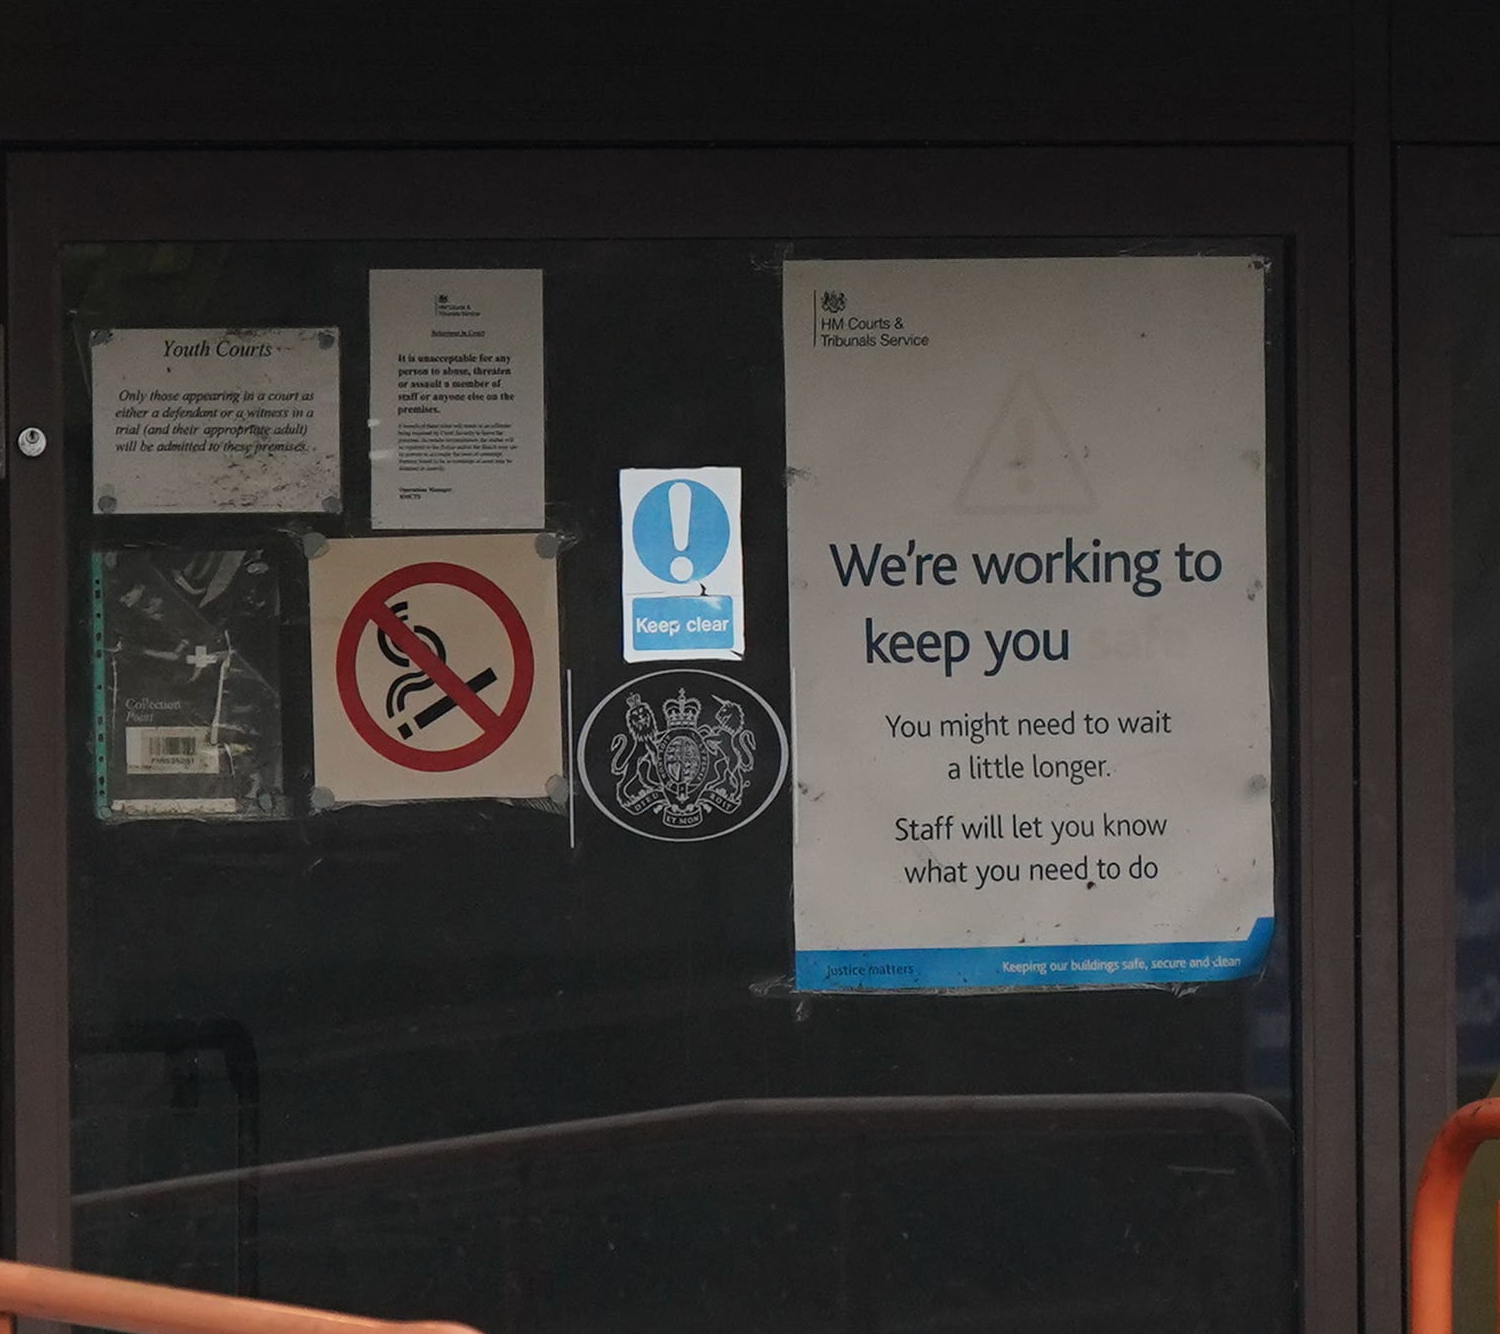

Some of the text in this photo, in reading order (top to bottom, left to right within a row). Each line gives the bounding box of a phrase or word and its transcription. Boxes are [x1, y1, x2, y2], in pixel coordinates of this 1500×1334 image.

[821, 316, 905, 331] HM Courts &
[163, 339, 273, 358] Youth Courts
[820, 332, 929, 348] Tribunals Service
[397, 353, 511, 366] It is unacceptable for any
[119, 389, 315, 405] Only those appearing in a court as
[115, 406, 315, 422] either a defendant or a witness in a
[115, 422, 308, 439] trial (and their appropriate adult)
[115, 440, 137, 452] will
[139, 440, 155, 452] be
[156, 438, 207, 452] admitted
[207, 442, 221, 452] to
[829, 536, 1223, 598] We're working to
[635, 616, 729, 637] Keep clear
[865, 616, 1069, 678] keep you
[885, 710, 1172, 745] You might need to wait
[947, 754, 1111, 786] a little longer.
[895, 812, 1167, 846] Staff will let you know
[903, 854, 1159, 889] what you need to do
[867, 964, 914, 976] matters
[1002, 954, 1241, 976] Keeping our buildings safe, secure and clean
